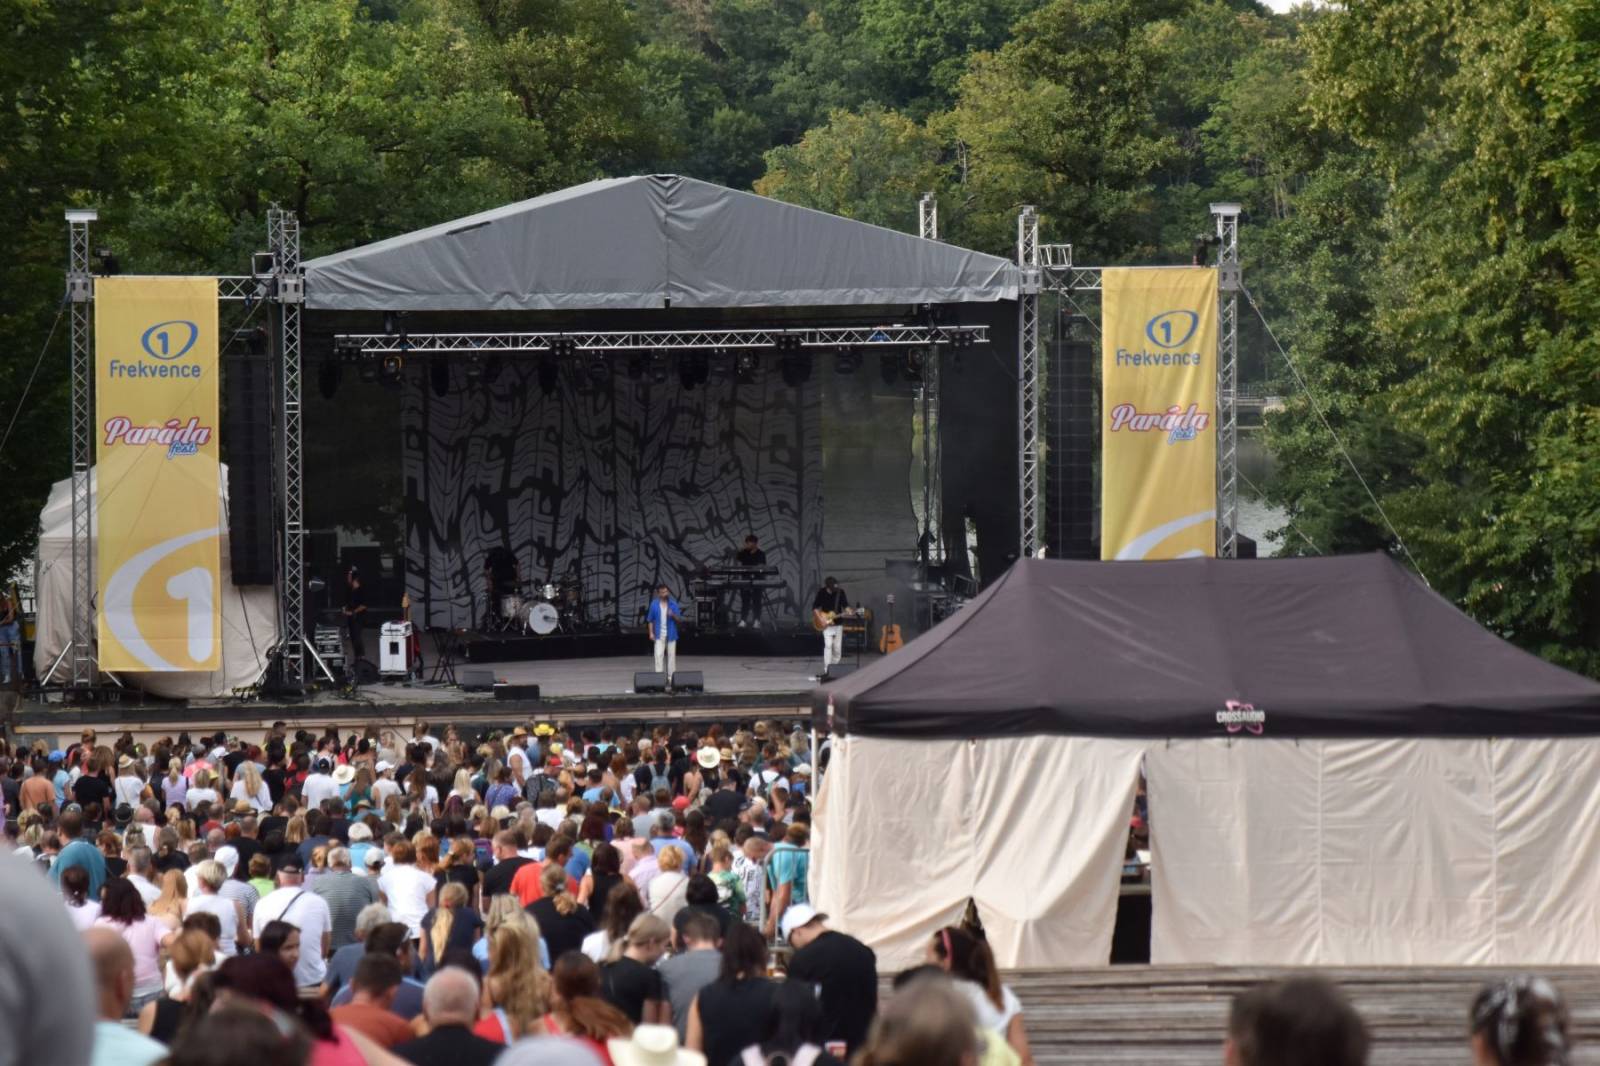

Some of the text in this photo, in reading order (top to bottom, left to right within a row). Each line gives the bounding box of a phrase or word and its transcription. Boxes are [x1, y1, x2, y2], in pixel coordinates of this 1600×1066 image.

[157, 332, 169, 355] 1
[1160, 321, 1171, 344] 1
[110, 360, 201, 377] Frekvence
[1116, 349, 1201, 366] Frekvence
[1111, 403, 1209, 432] Paráda
[104, 416, 211, 446] Paráda
[167, 440, 198, 460] fest
[166, 566, 213, 663] 1
